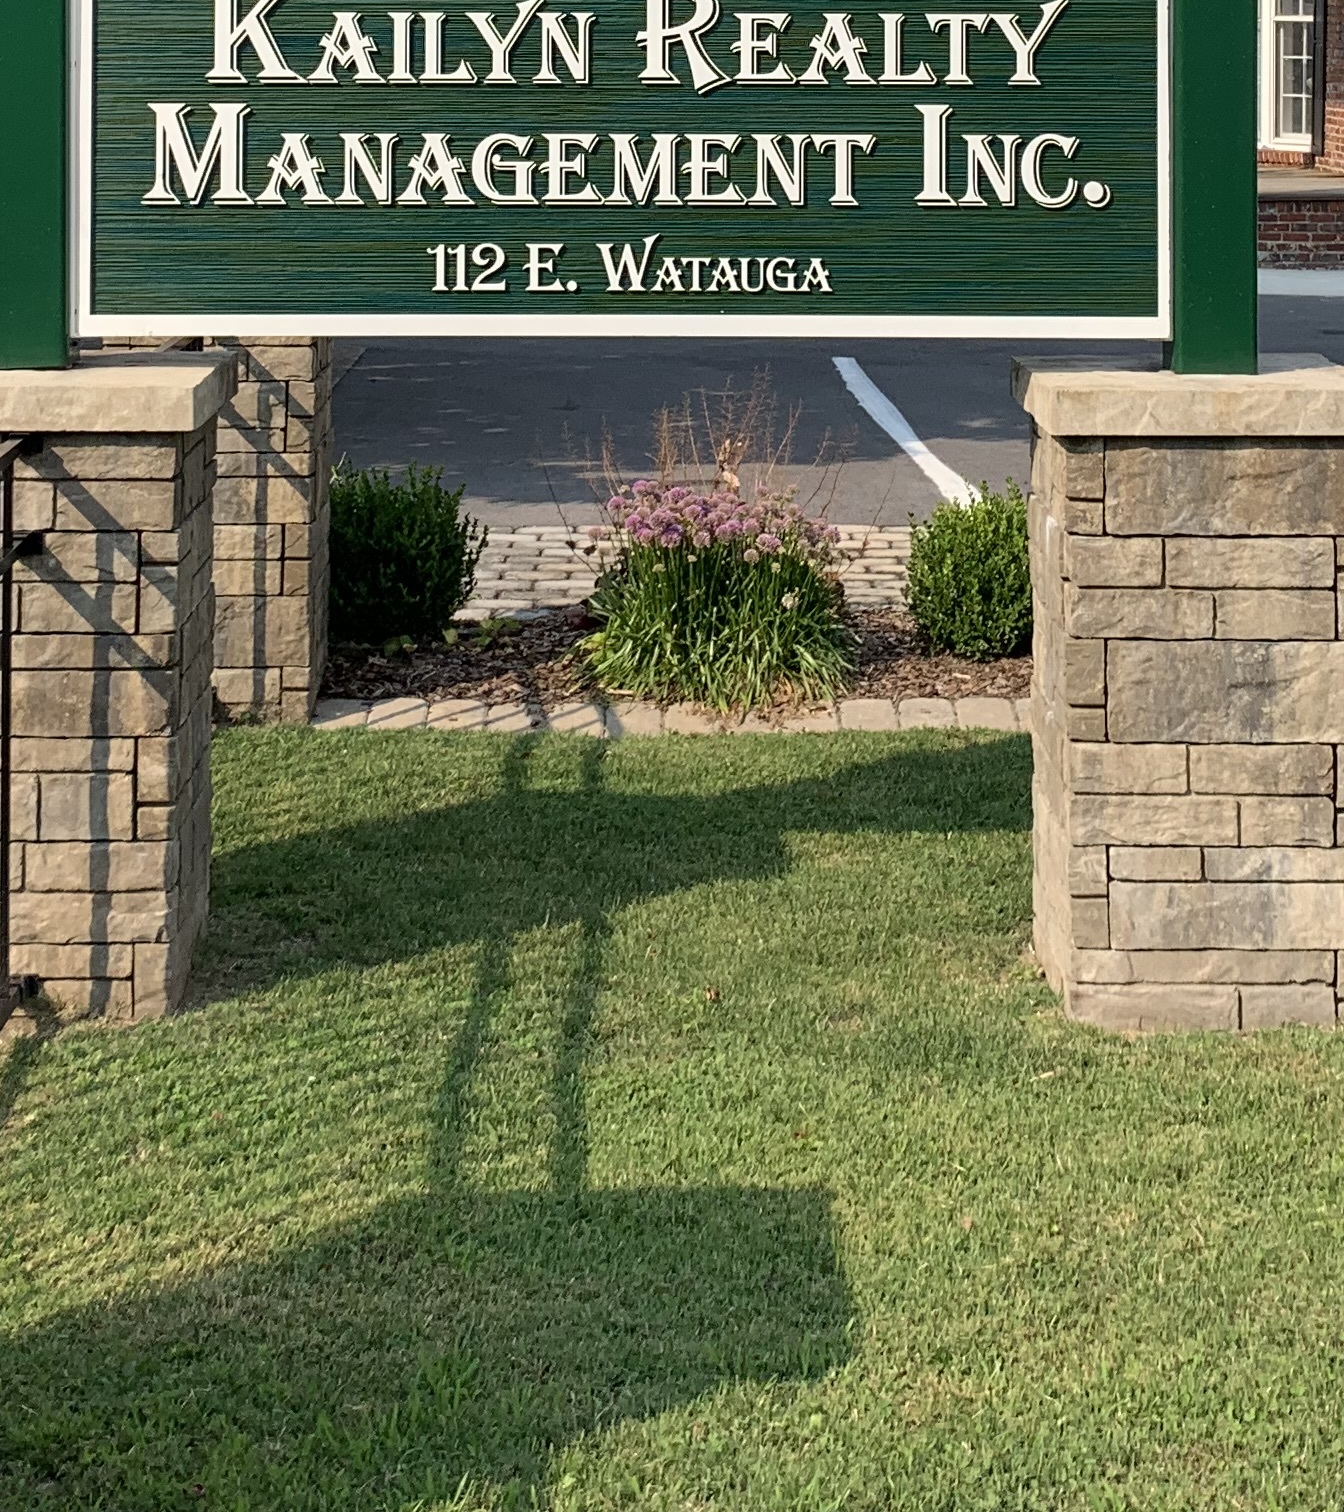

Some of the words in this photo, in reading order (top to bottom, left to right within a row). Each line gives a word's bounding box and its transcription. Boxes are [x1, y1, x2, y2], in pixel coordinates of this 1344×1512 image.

[140, 102, 876, 206] MANAGEMENT
[913, 104, 1112, 209] INC.
[426, 242, 506, 292] 112
[522, 243, 578, 292] E.
[595, 232, 833, 293] WATAUGA
